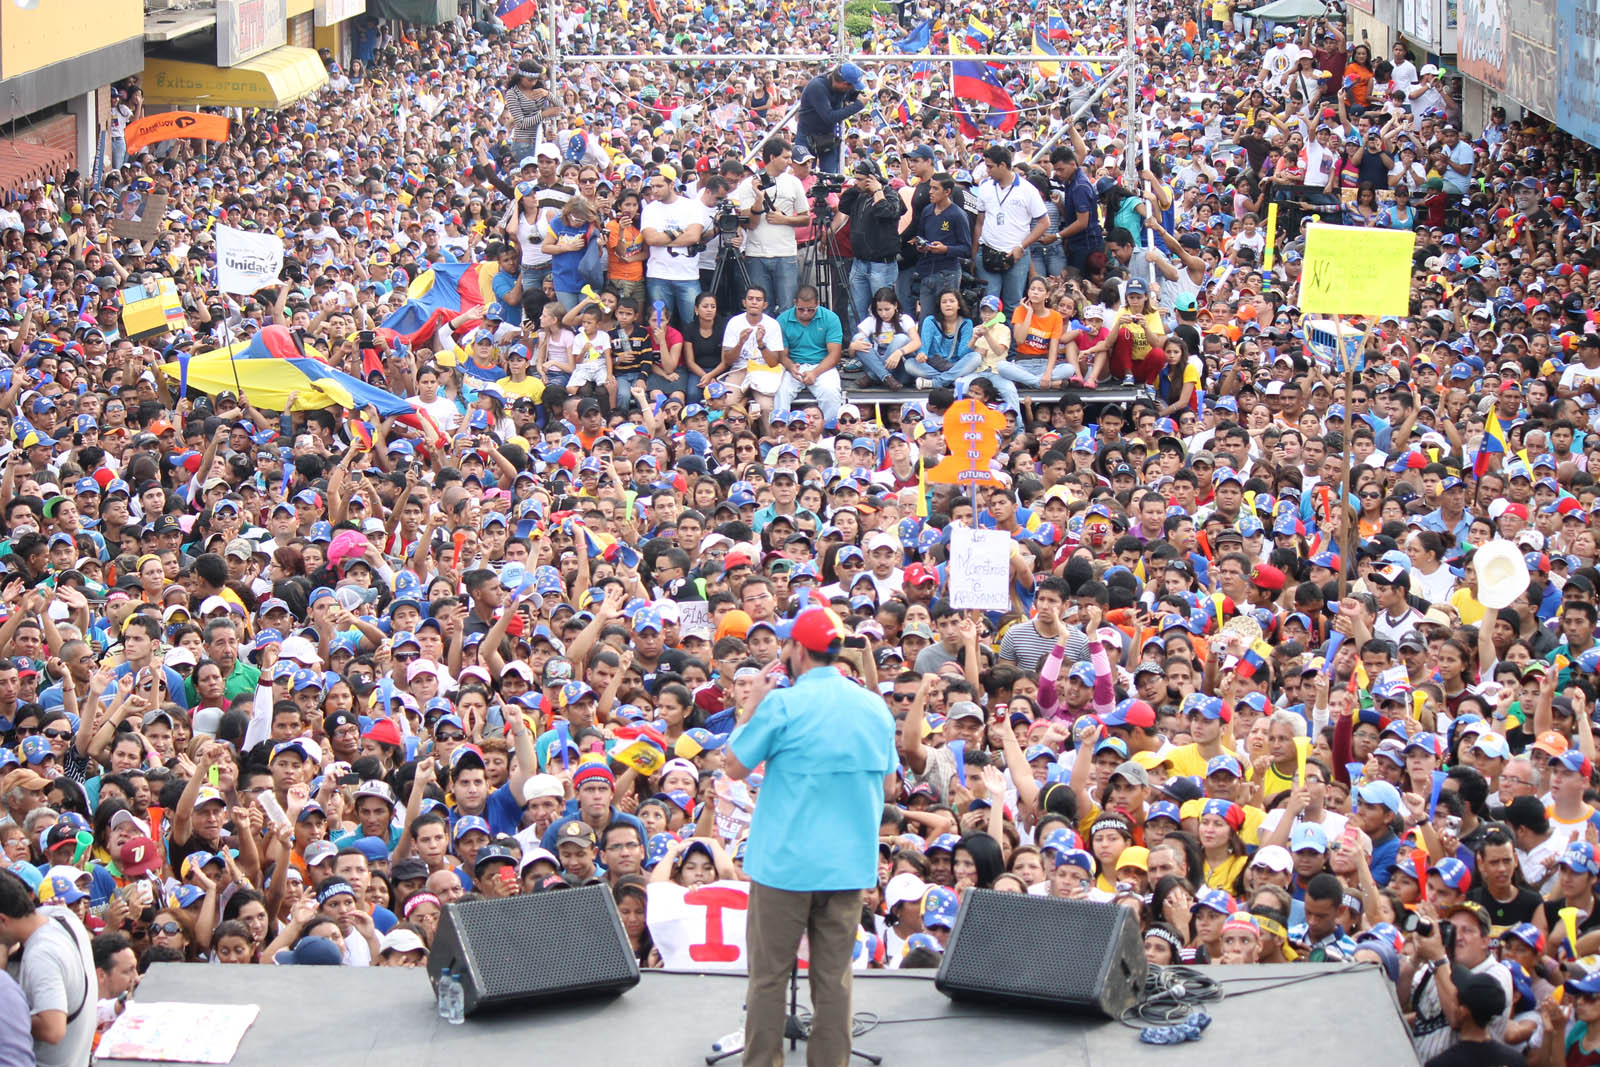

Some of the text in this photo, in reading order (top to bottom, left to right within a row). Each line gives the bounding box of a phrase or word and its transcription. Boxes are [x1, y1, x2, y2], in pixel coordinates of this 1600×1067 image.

[961, 415, 985, 423] VOTA
[965, 432, 982, 440] POR
[968, 450, 980, 458] TU
[959, 471, 991, 480] FUTURO
